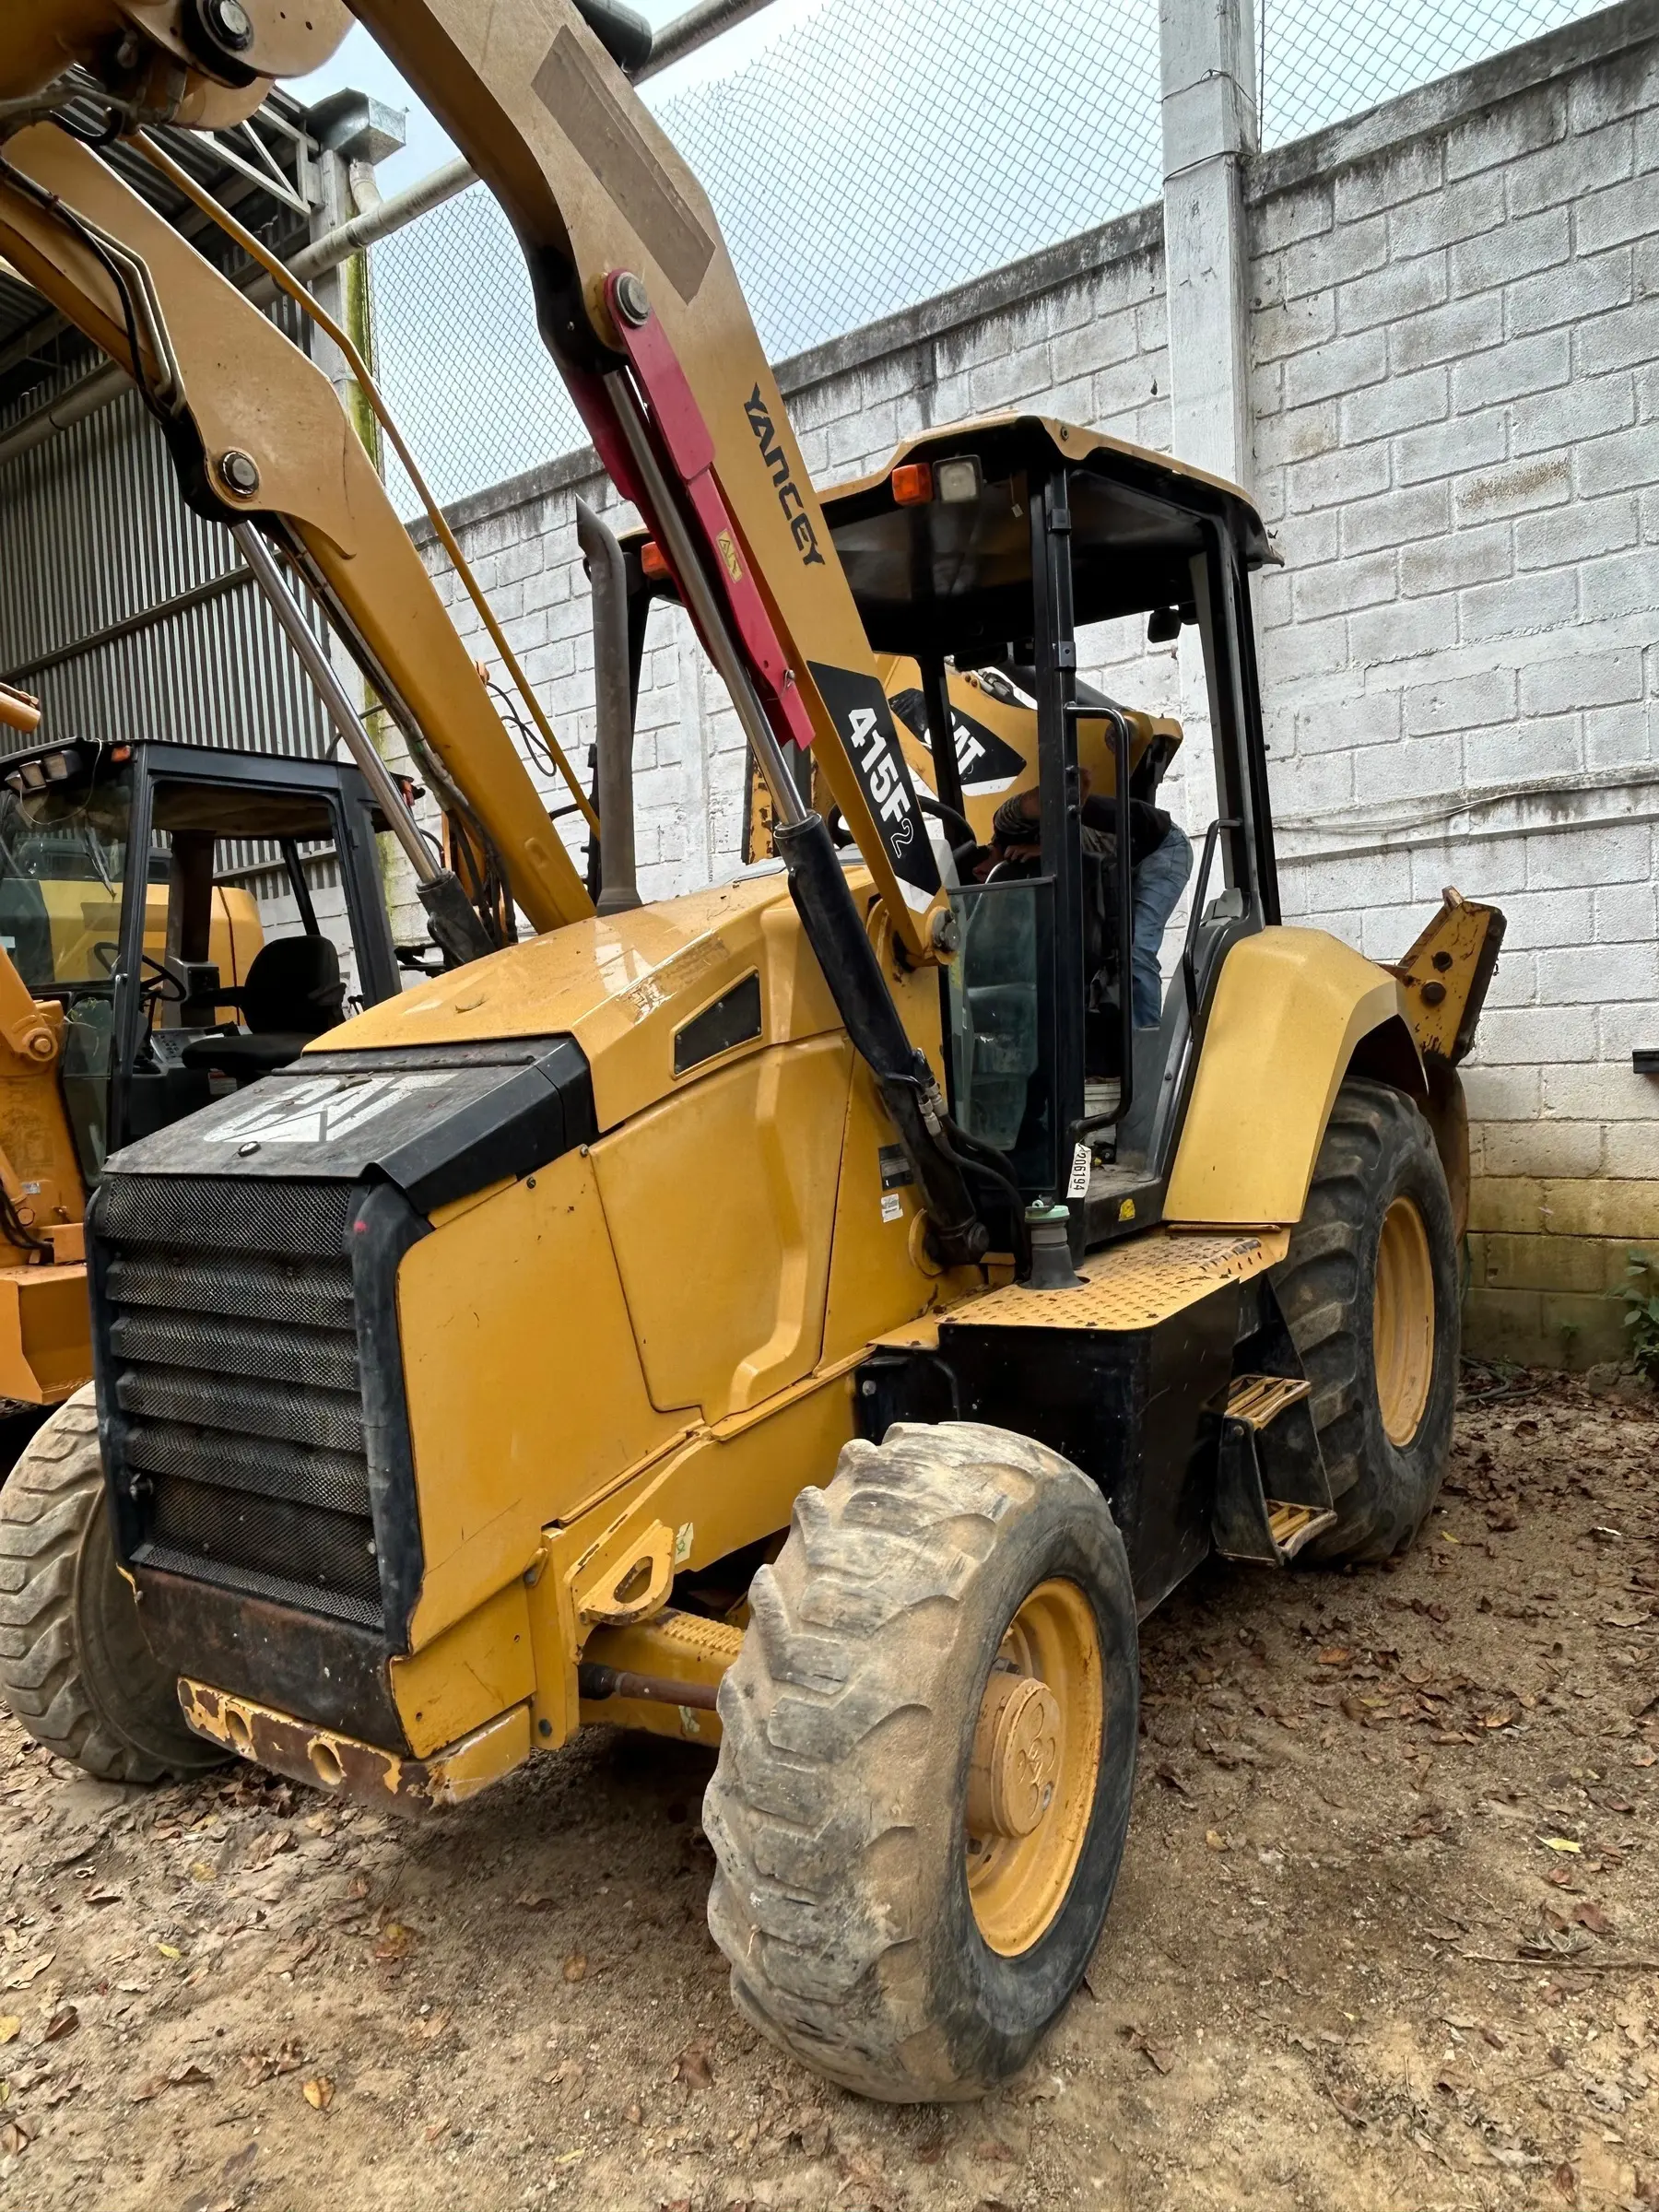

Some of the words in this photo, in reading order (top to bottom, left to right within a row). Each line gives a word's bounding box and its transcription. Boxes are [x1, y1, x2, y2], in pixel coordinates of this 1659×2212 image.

[744, 382, 826, 566] YANCEY
[203, 1073, 460, 1143] CAT
[1073, 1152, 1087, 1191] 206194
